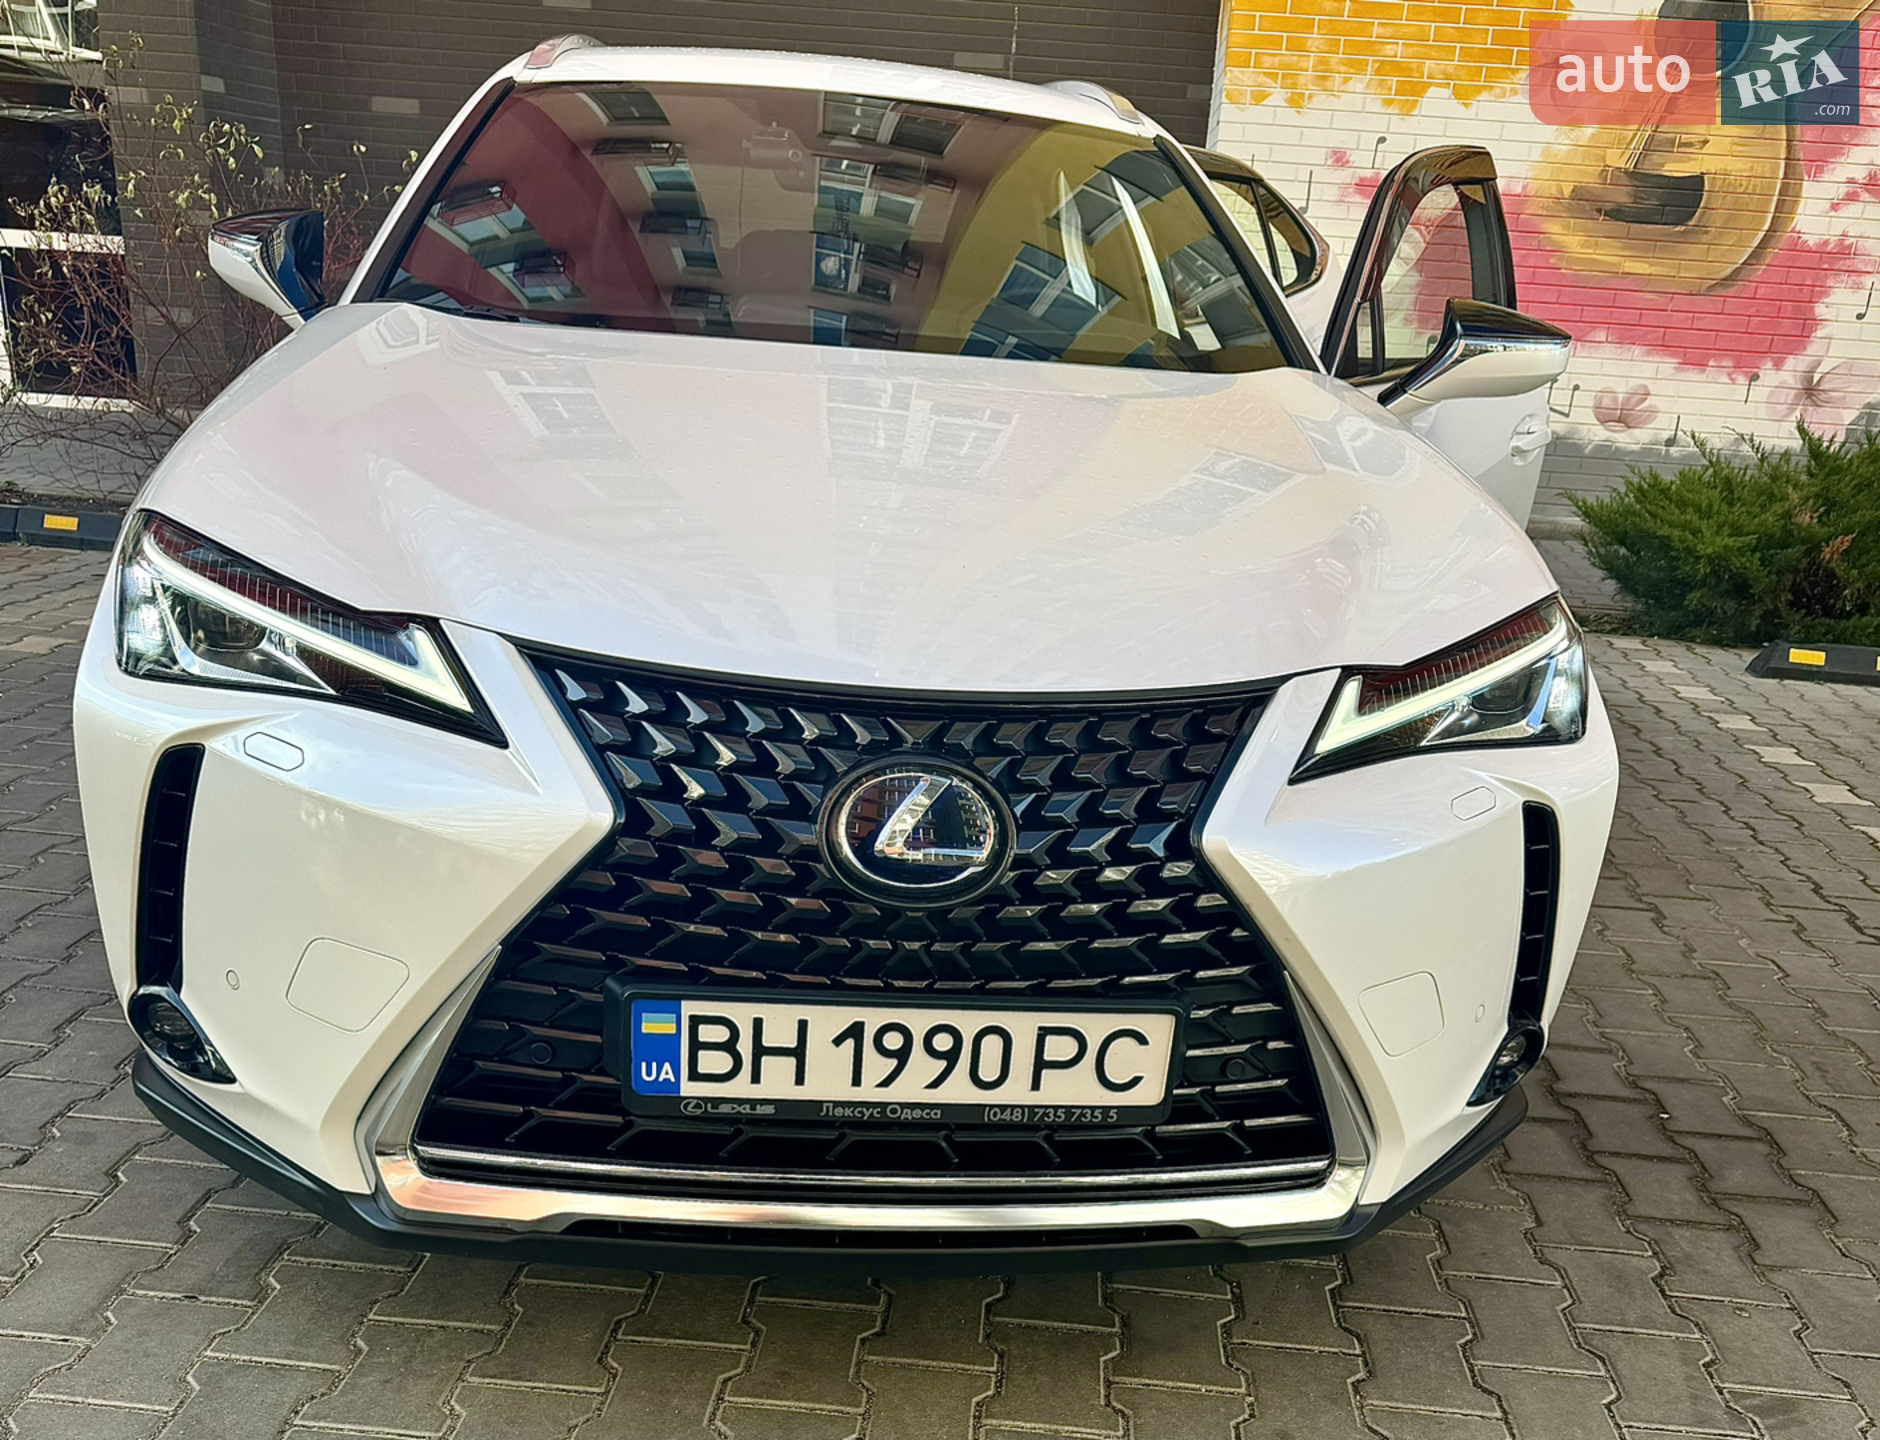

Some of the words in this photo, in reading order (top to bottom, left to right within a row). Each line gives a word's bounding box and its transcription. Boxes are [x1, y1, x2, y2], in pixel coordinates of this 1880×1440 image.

[687, 1013, 809, 1087] BH
[831, 1020, 1013, 1092] 1990
[1030, 1025, 1150, 1093] PC
[641, 1060, 676, 1083] UA
[707, 1103, 776, 1115] LEXUS
[819, 1103, 881, 1120] Лексус
[885, 1104, 942, 1120] Одеса
[983, 1106, 1028, 1122] (048)
[1033, 1107, 1066, 1122] 735
